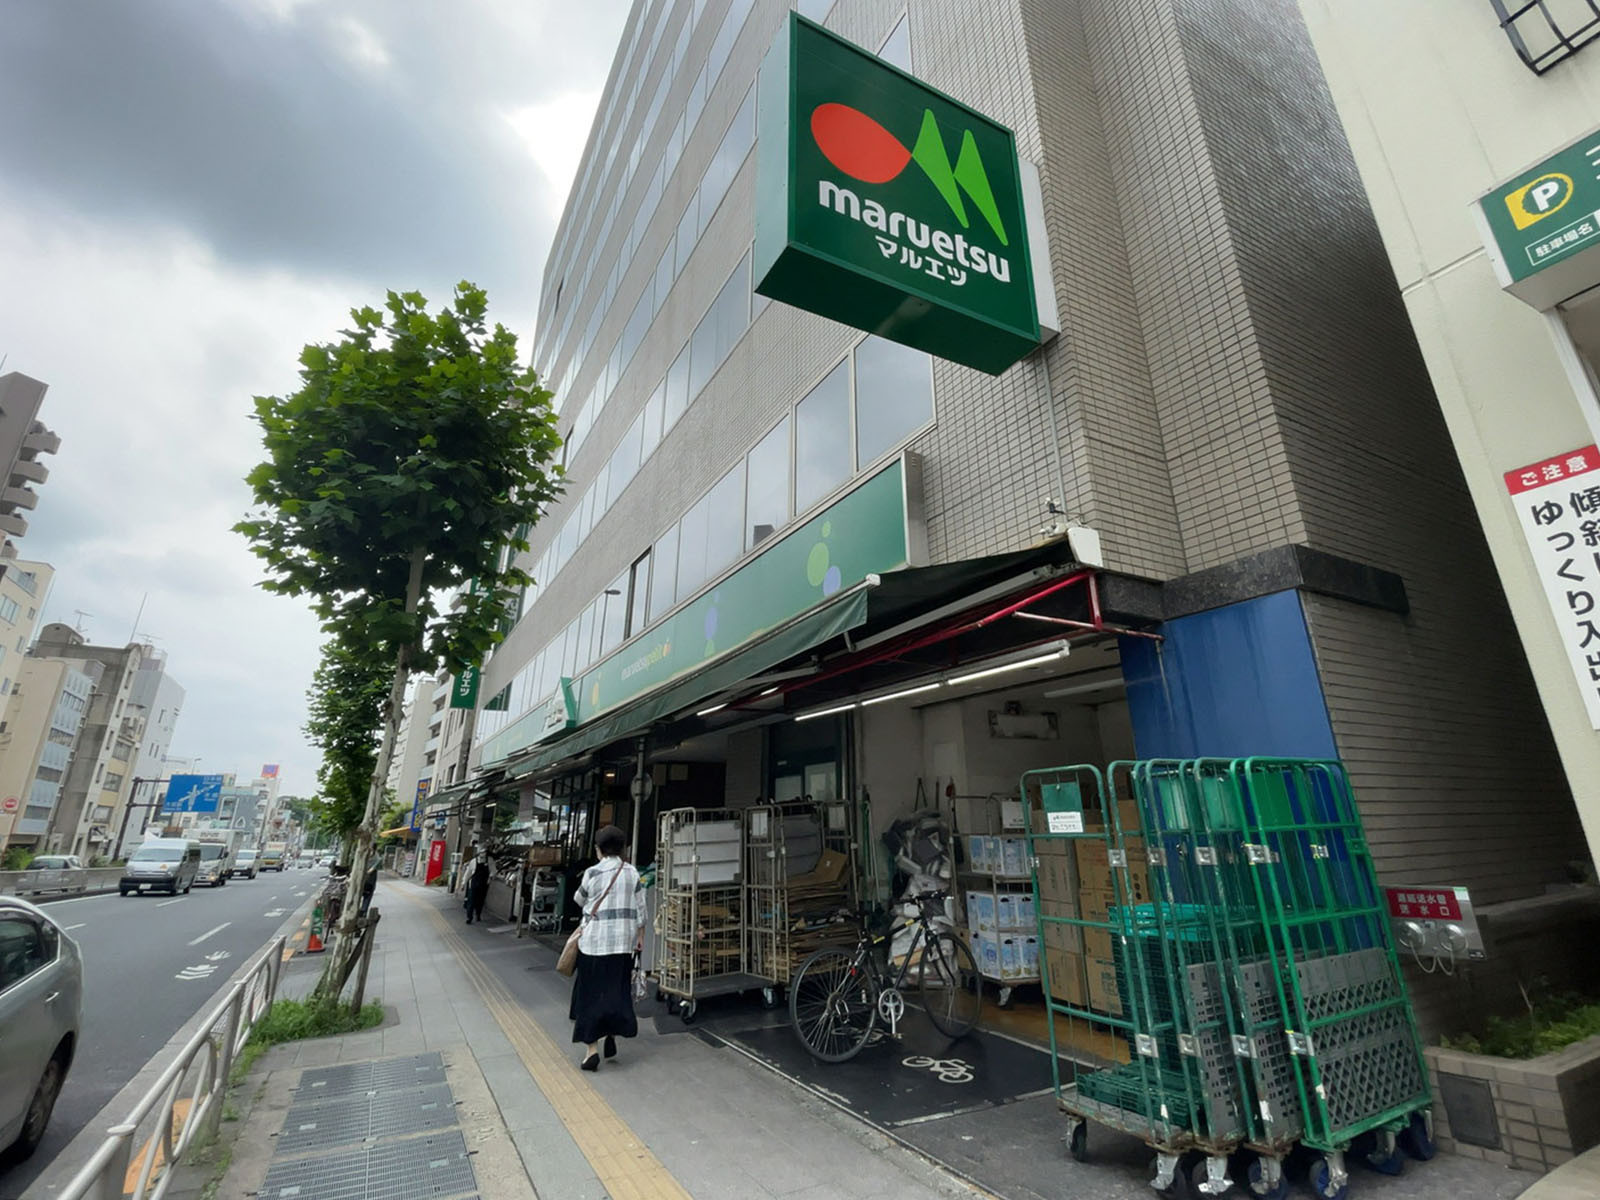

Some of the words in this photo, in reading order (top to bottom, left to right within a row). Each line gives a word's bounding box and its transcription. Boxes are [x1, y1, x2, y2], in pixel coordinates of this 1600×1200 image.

[1531, 181, 1560, 212] P
[818, 180, 1011, 283] maruetsu
[875, 235, 967, 286] マルエツ
[1520, 455, 1589, 486] ご注意
